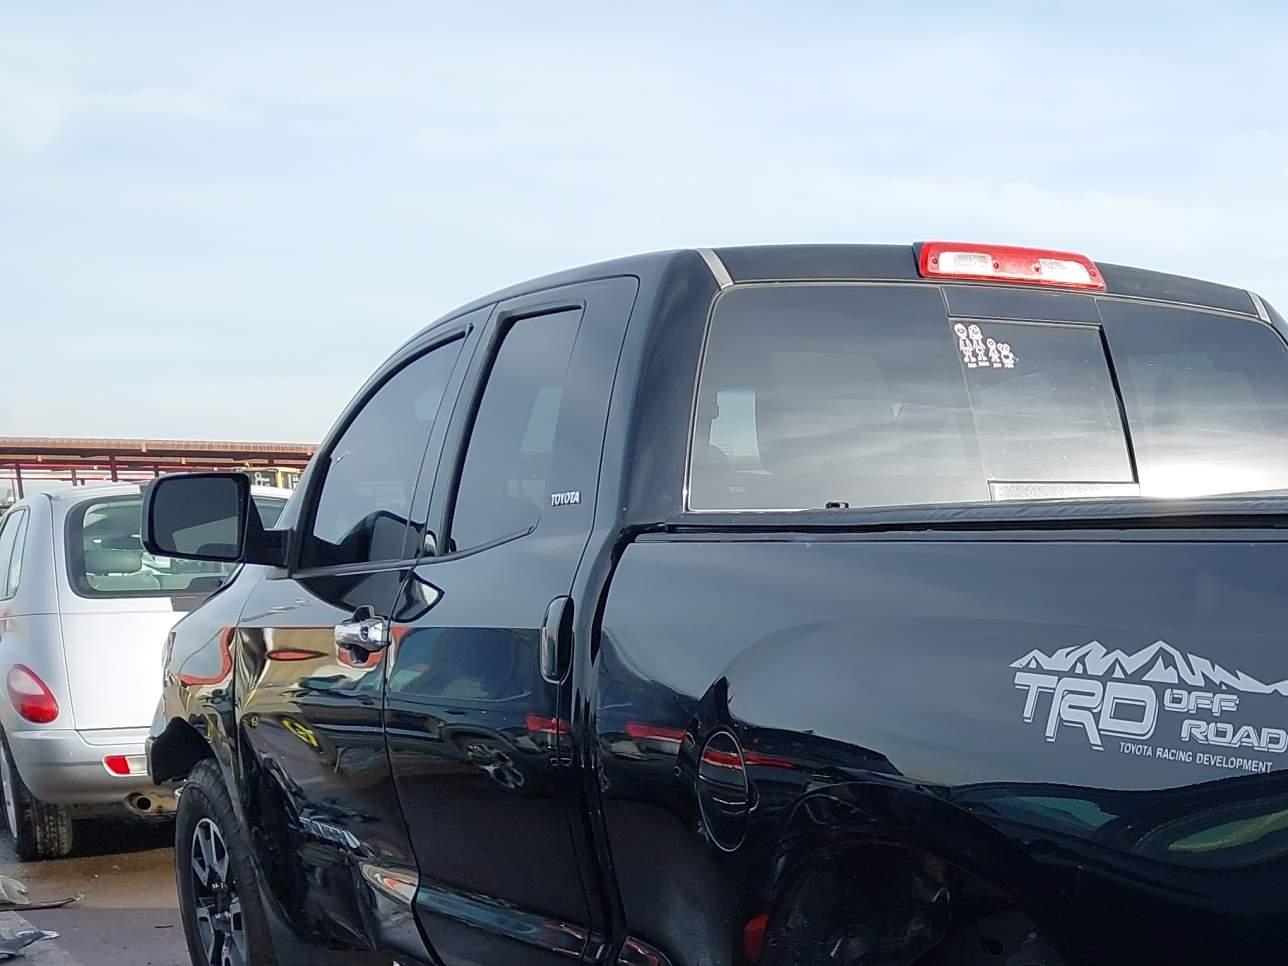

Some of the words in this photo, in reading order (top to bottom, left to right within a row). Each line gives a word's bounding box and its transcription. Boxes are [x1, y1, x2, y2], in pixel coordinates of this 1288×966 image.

[551, 491, 580, 506] TOYOTA
[1014, 671, 1160, 752] TRD
[1163, 688, 1240, 716] OFF
[1119, 741, 1153, 758] TOYOTA
[1156, 747, 1193, 763] RACING
[1196, 752, 1273, 774] DEVELOPMENT
